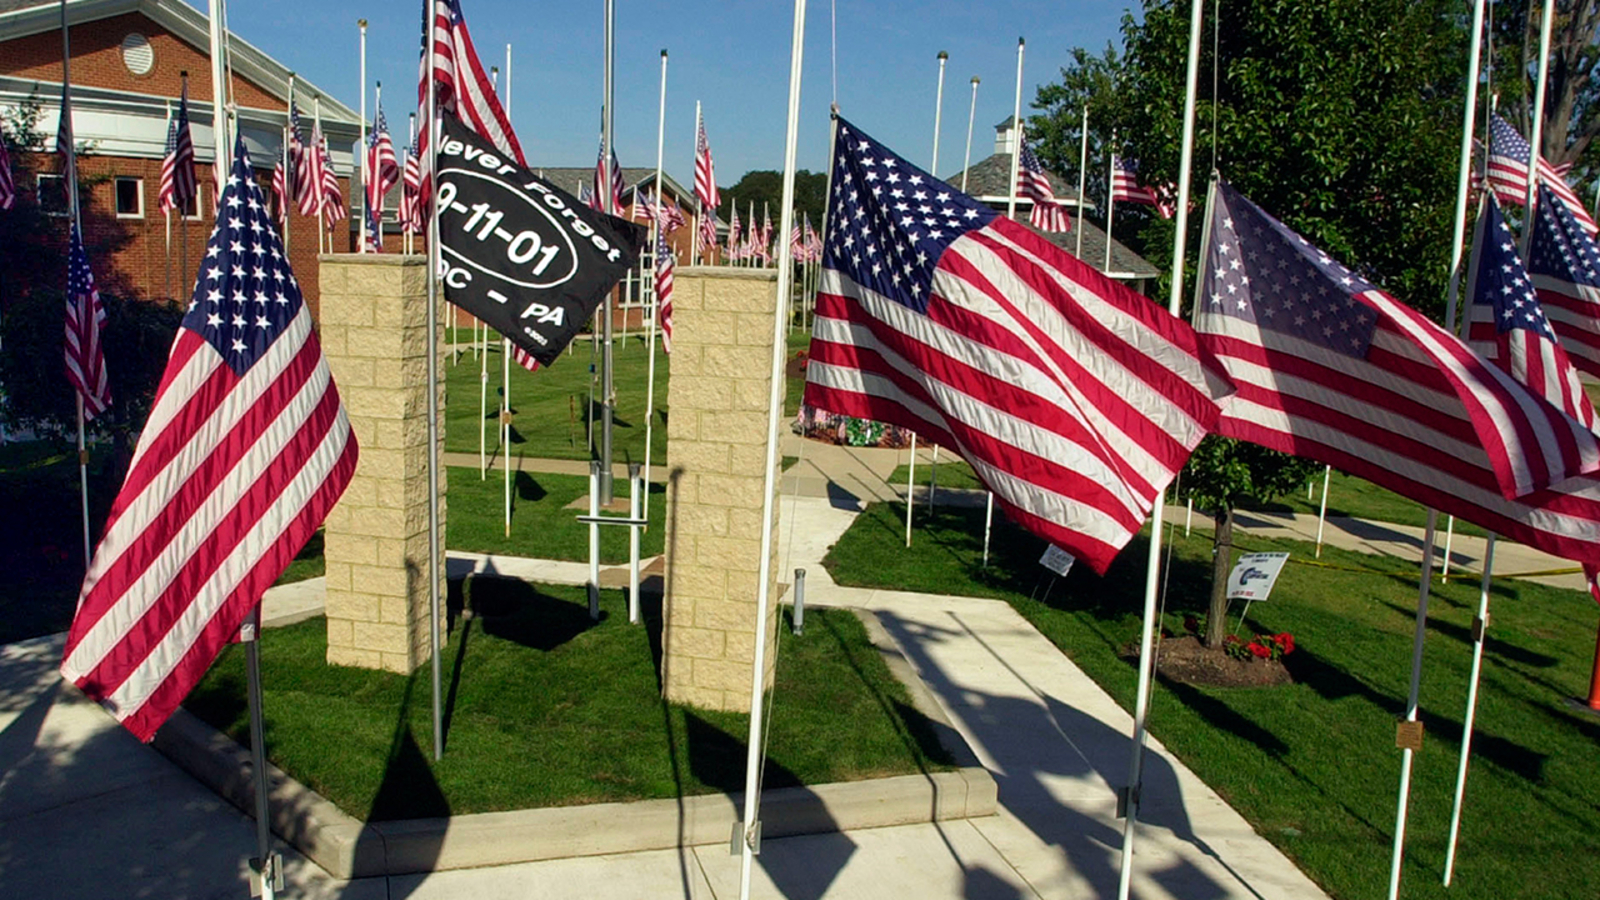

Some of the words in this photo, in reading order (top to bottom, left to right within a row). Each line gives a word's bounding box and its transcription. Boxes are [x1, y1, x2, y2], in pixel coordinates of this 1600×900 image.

[437, 182, 559, 276] 9-11-01
[524, 181, 621, 262] Forget
[520, 302, 565, 326] PA
